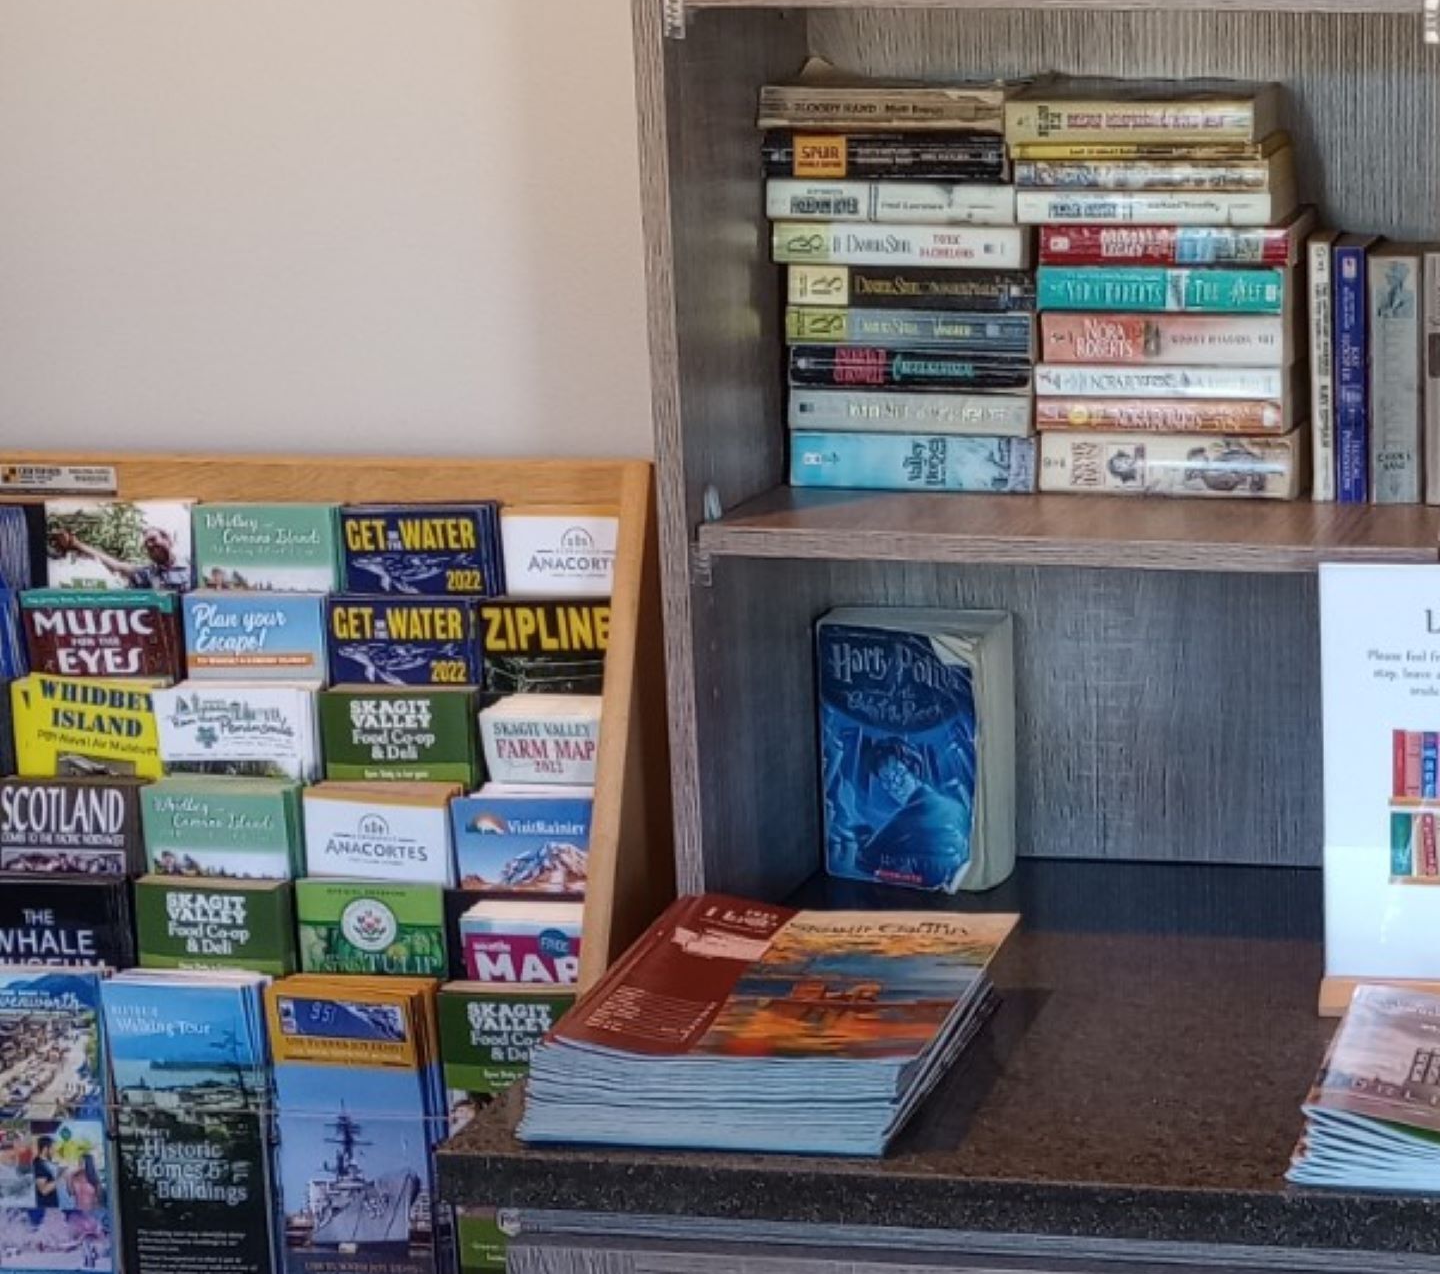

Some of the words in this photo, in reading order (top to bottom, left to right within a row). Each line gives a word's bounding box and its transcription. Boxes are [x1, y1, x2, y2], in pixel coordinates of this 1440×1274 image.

[800, 145, 840, 160] SPUR
[1084, 318, 1124, 341] NORA
[1075, 336, 1133, 359] ROBERTS
[345, 519, 386, 551] GET
[399, 519, 476, 551] WATER
[446, 571, 483, 591] 2022
[33, 608, 154, 637] MUSIC
[191, 602, 237, 629] Plan
[242, 611, 287, 634] your
[333, 607, 374, 640] GET
[386, 607, 463, 640] WATER
[196, 627, 266, 656] Escape!
[56, 647, 144, 674] EYES
[830, 642, 887, 685] Harry
[1367, 650, 1402, 662] Please
[1406, 651, 1427, 662] feel
[430, 660, 467, 683] 2022
[1402, 669, 1432, 680] leave
[350, 700, 430, 714] SKAGIT
[50, 706, 143, 738] ISLAND
[350, 713, 432, 729] VALLEY
[493, 722, 540, 735] SKAGIT
[544, 722, 590, 737] VALLEY
[352, 729, 388, 745] Food
[391, 729, 435, 748] Co-op
[387, 744, 418, 760] Deli
[495, 739, 556, 761] FARM
[559, 740, 596, 761] MAP
[1, 786, 125, 834] SCOTLAND
[325, 838, 428, 862] ANACORTES
[165, 892, 246, 909] SKAGIT
[23, 909, 55, 925] THE
[167, 907, 248, 924] VALLEY
[167, 924, 203, 938] Food
[206, 925, 250, 943] Co-op
[185, 939, 200, 954] &
[201, 939, 232, 955] Deli
[473, 954, 578, 983] MAP
[467, 1002, 551, 1018] SKAGIT
[116, 1017, 175, 1039] Walking
[179, 1021, 212, 1035] Tour
[469, 1016, 551, 1031] VALLEY
[471, 1030, 505, 1046] Food
[143, 1138, 223, 1159] Historic
[136, 1158, 197, 1178] Homes
[155, 1178, 249, 1205] Buildings
